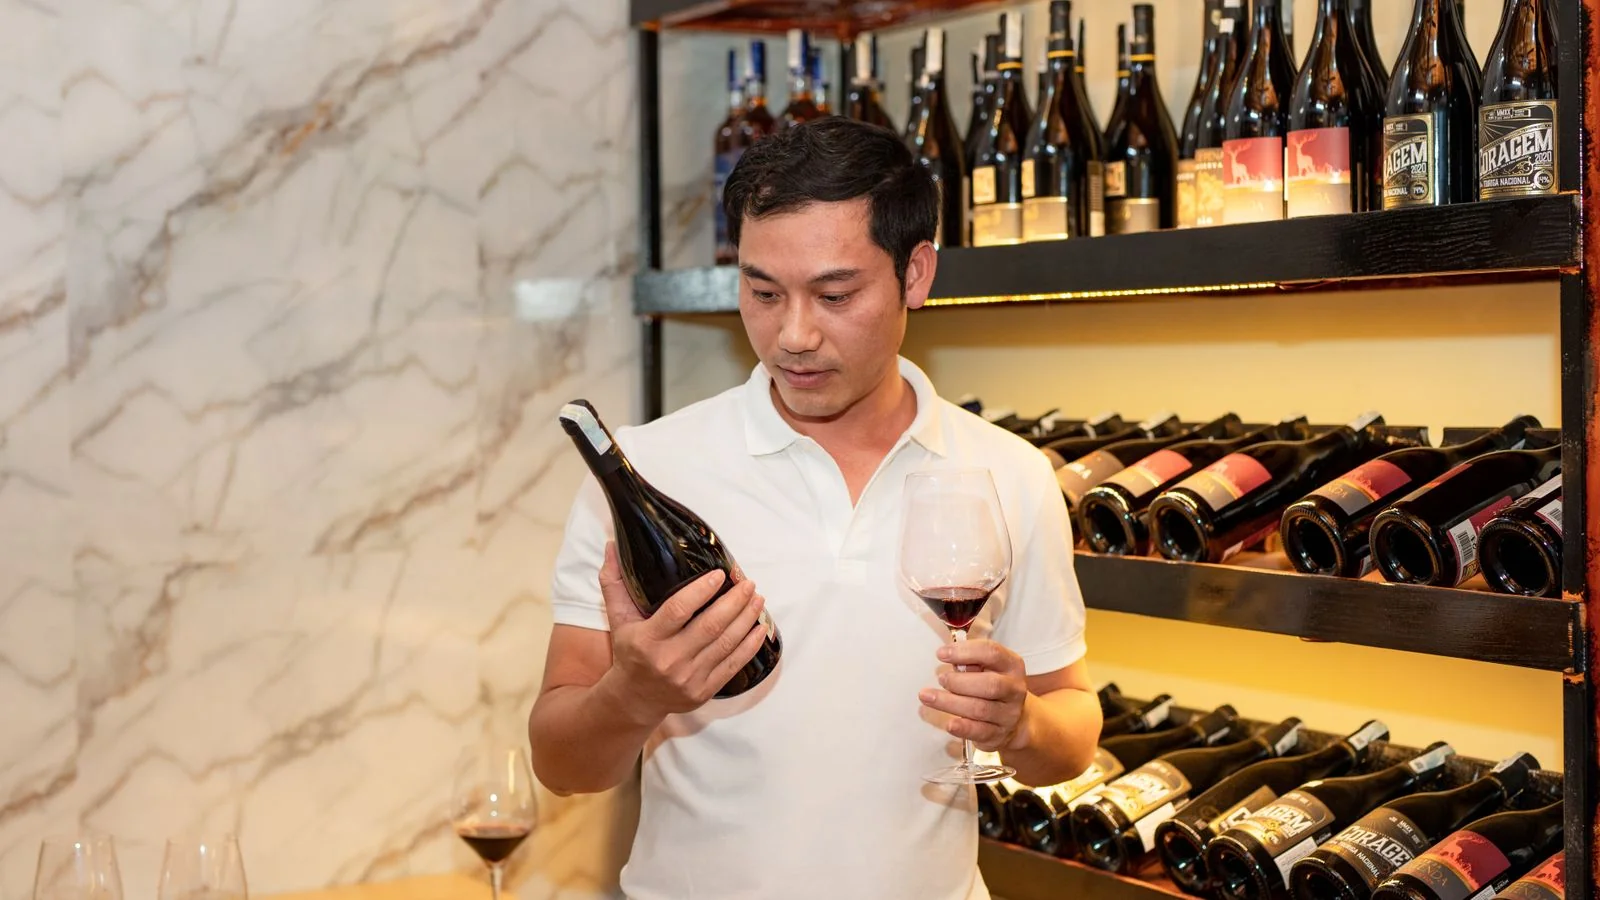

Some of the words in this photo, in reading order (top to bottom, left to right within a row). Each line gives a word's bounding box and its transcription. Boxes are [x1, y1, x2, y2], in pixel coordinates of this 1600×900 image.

[1534, 151, 1552, 162] 2020
[1411, 162, 1427, 174] 2020
[1499, 176, 1531, 186] NACIONAL
[1336, 825, 1412, 867] CORAGE
[1357, 851, 1380, 878] NACIONAL
